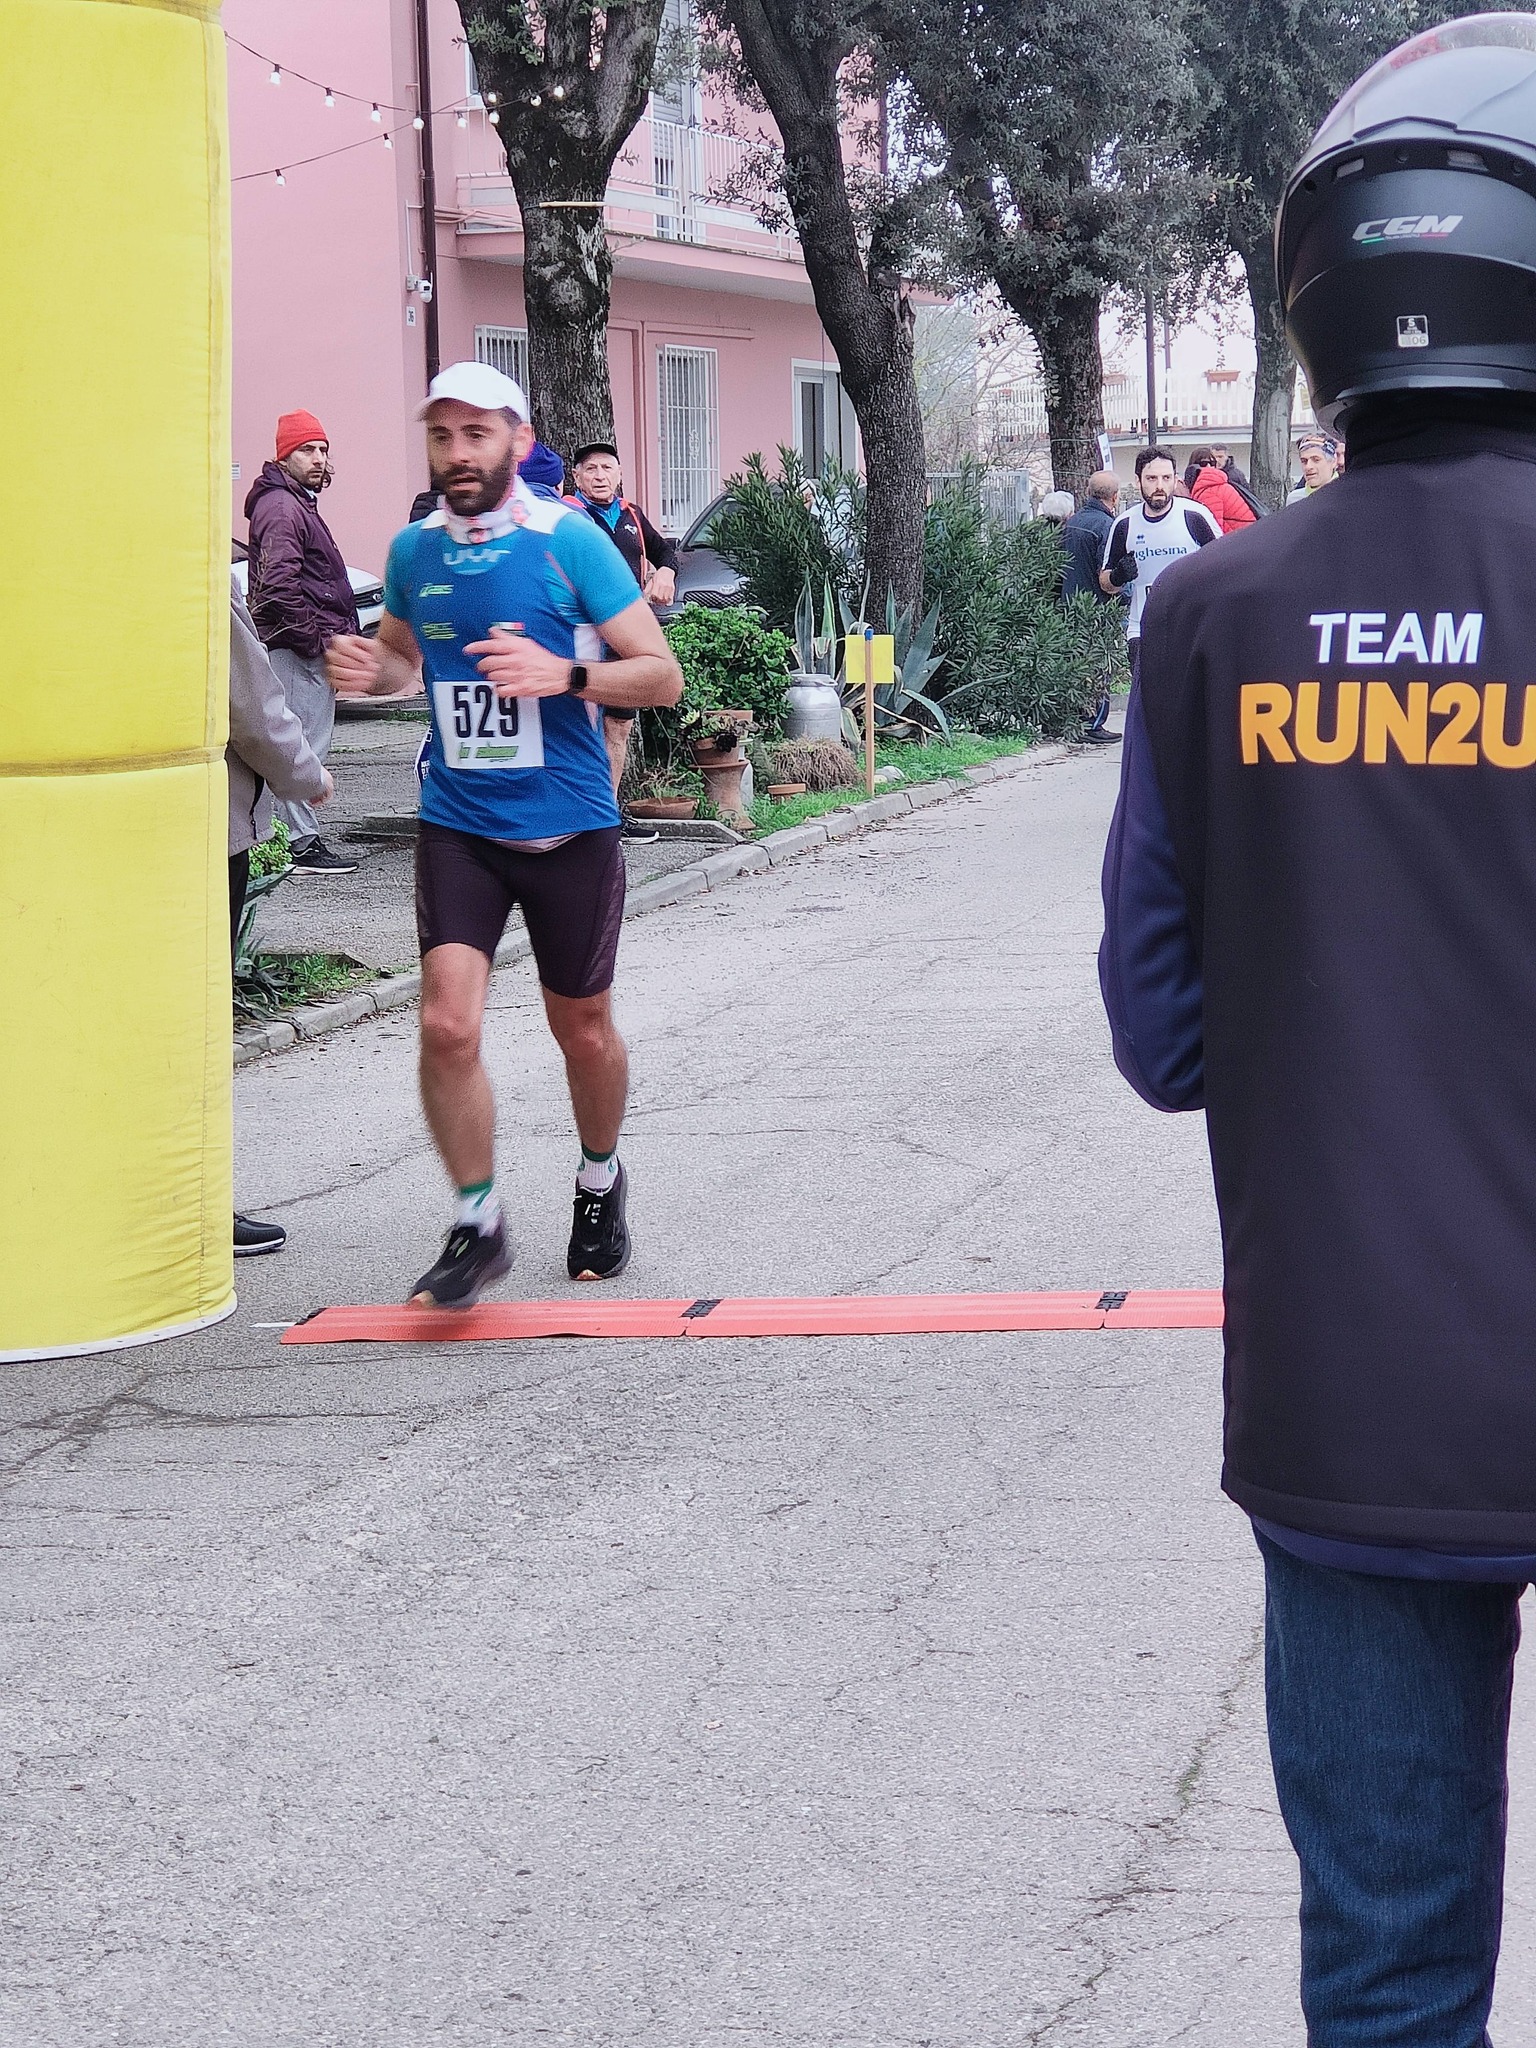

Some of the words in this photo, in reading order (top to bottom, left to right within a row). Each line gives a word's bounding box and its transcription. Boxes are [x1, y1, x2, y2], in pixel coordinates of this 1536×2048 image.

[1352, 215, 1464, 241] CGM
[1309, 612, 1483, 664] TEAM
[452, 684, 519, 738] 529
[1240, 682, 1536, 769] RUN2U
